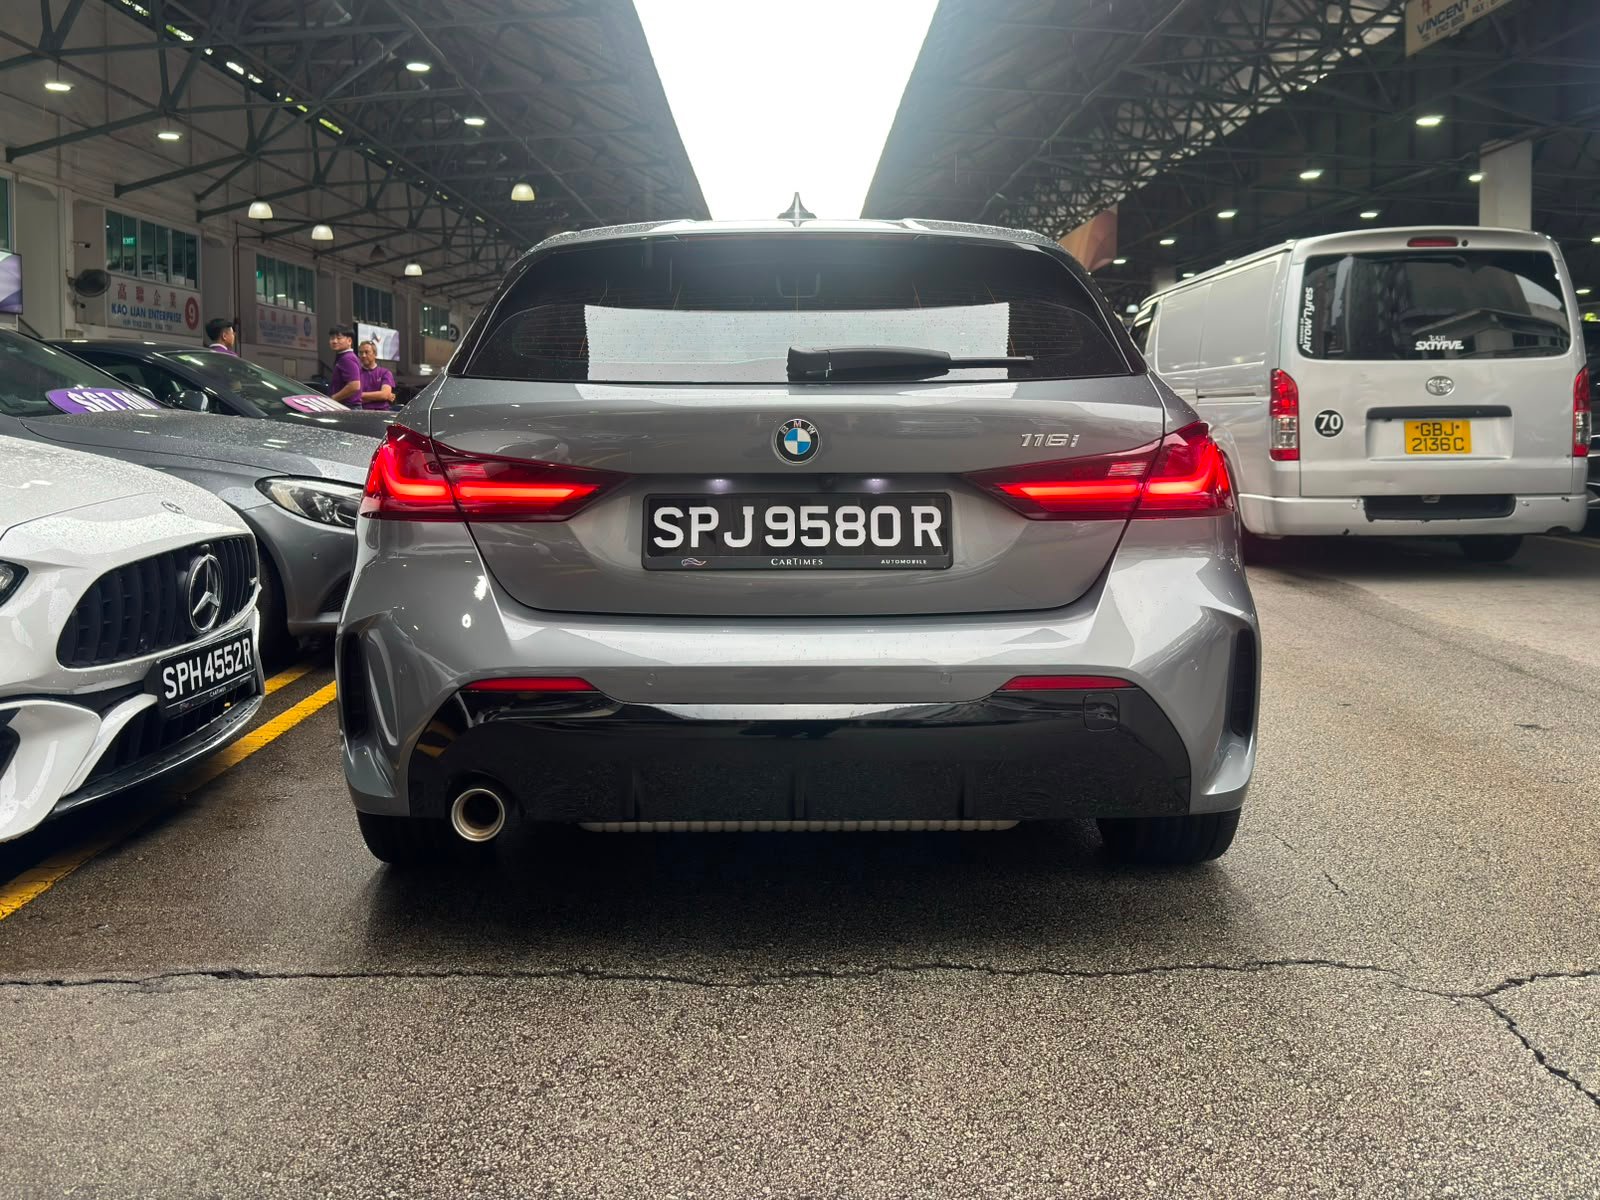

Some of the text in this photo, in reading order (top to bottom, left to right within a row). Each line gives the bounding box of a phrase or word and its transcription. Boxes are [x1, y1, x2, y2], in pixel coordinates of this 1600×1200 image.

[111, 303, 128, 316] KAO
[148, 308, 182, 323] ENTERPRISE
[188, 303, 196, 323] 9
[780, 420, 816, 435] BMW
[1318, 414, 1341, 430] 70
[1420, 422, 1455, 437] GBJ
[1021, 433, 1080, 448] 116i
